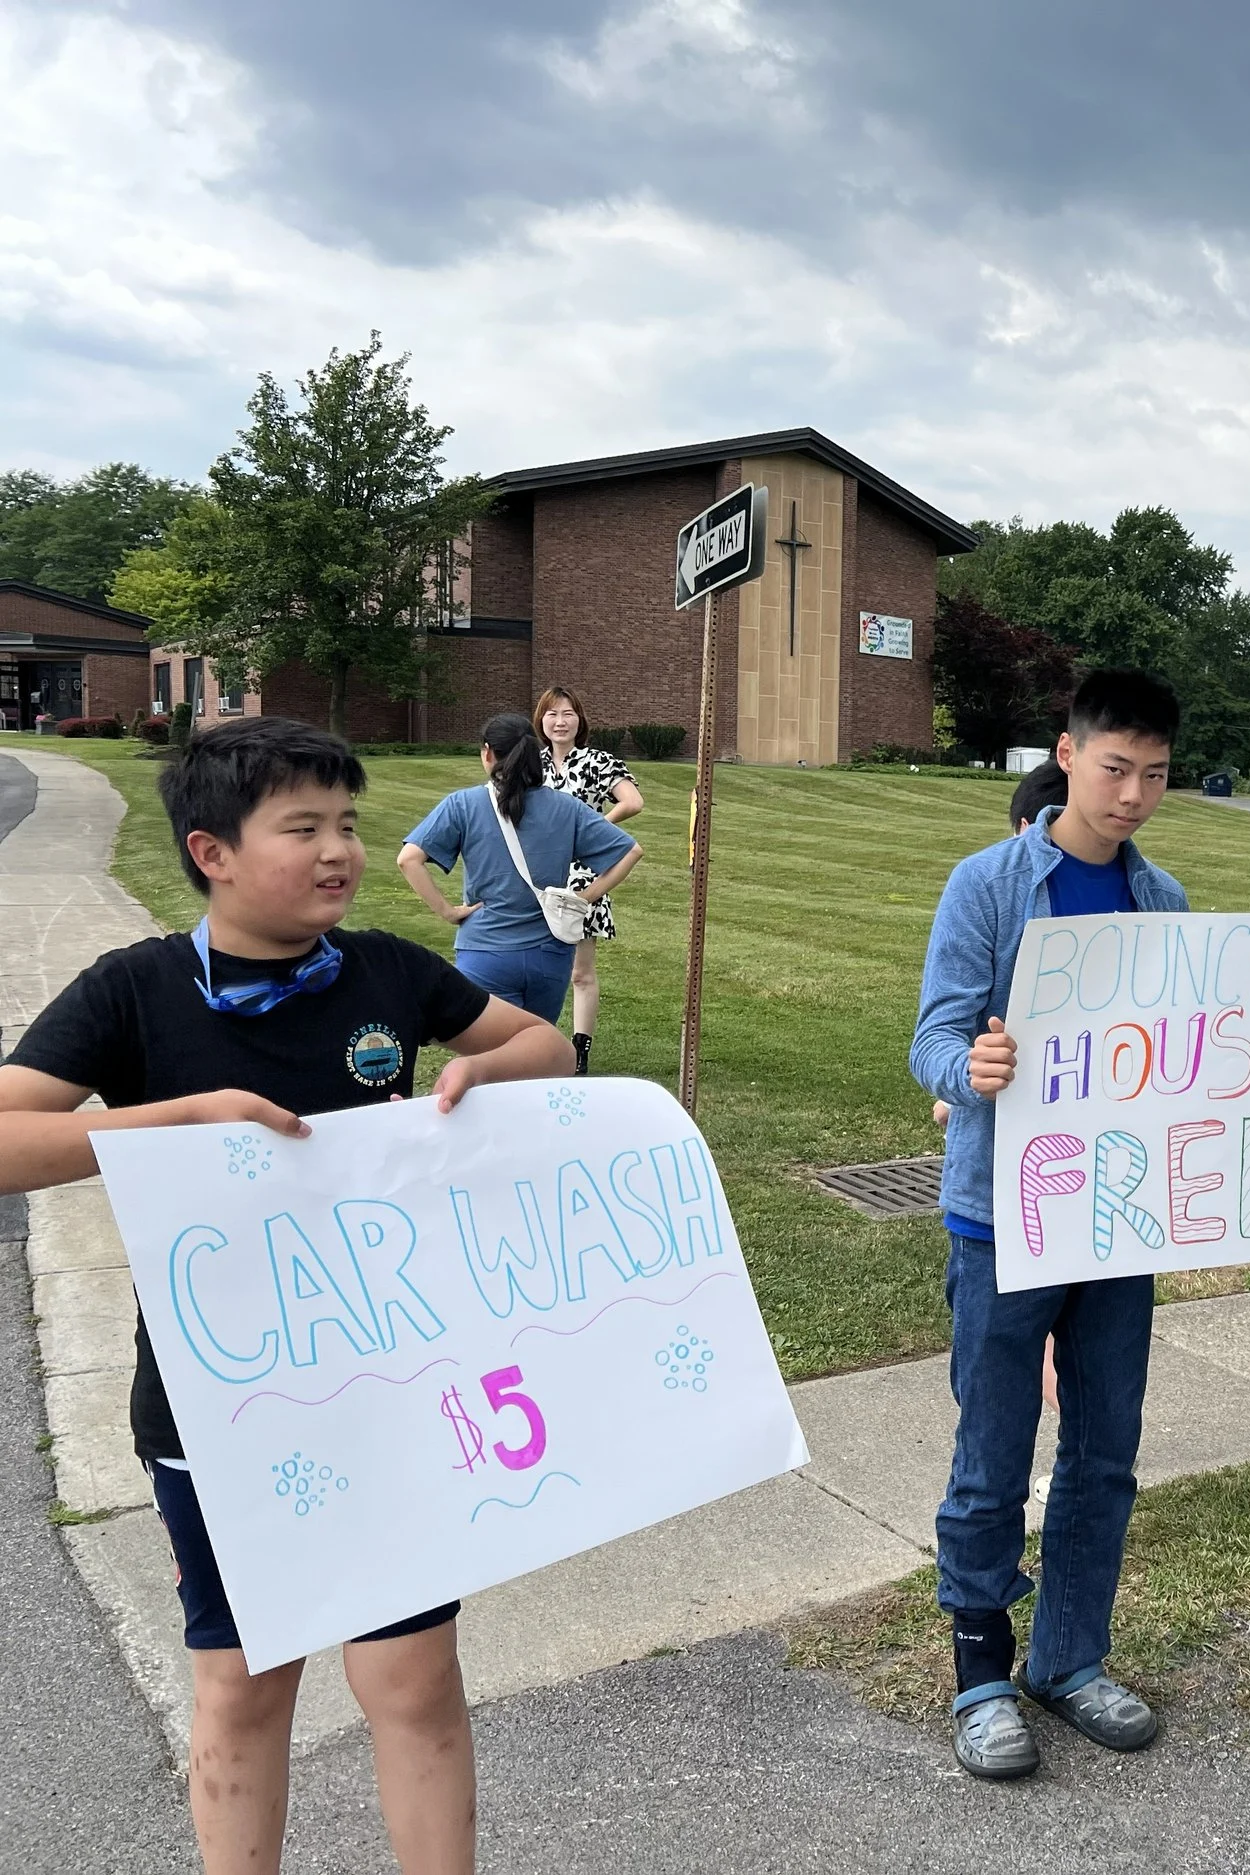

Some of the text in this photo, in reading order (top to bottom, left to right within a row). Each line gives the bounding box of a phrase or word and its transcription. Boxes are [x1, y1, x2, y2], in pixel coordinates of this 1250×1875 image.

[695, 515, 743, 571] ONE WAY
[888, 638, 909, 648] Growing
[896, 648, 909, 656] Serve
[349, 1023, 397, 1045] O'NEILL
[169, 1138, 723, 1384] CAR WASH
[441, 1364, 547, 1474] $5
